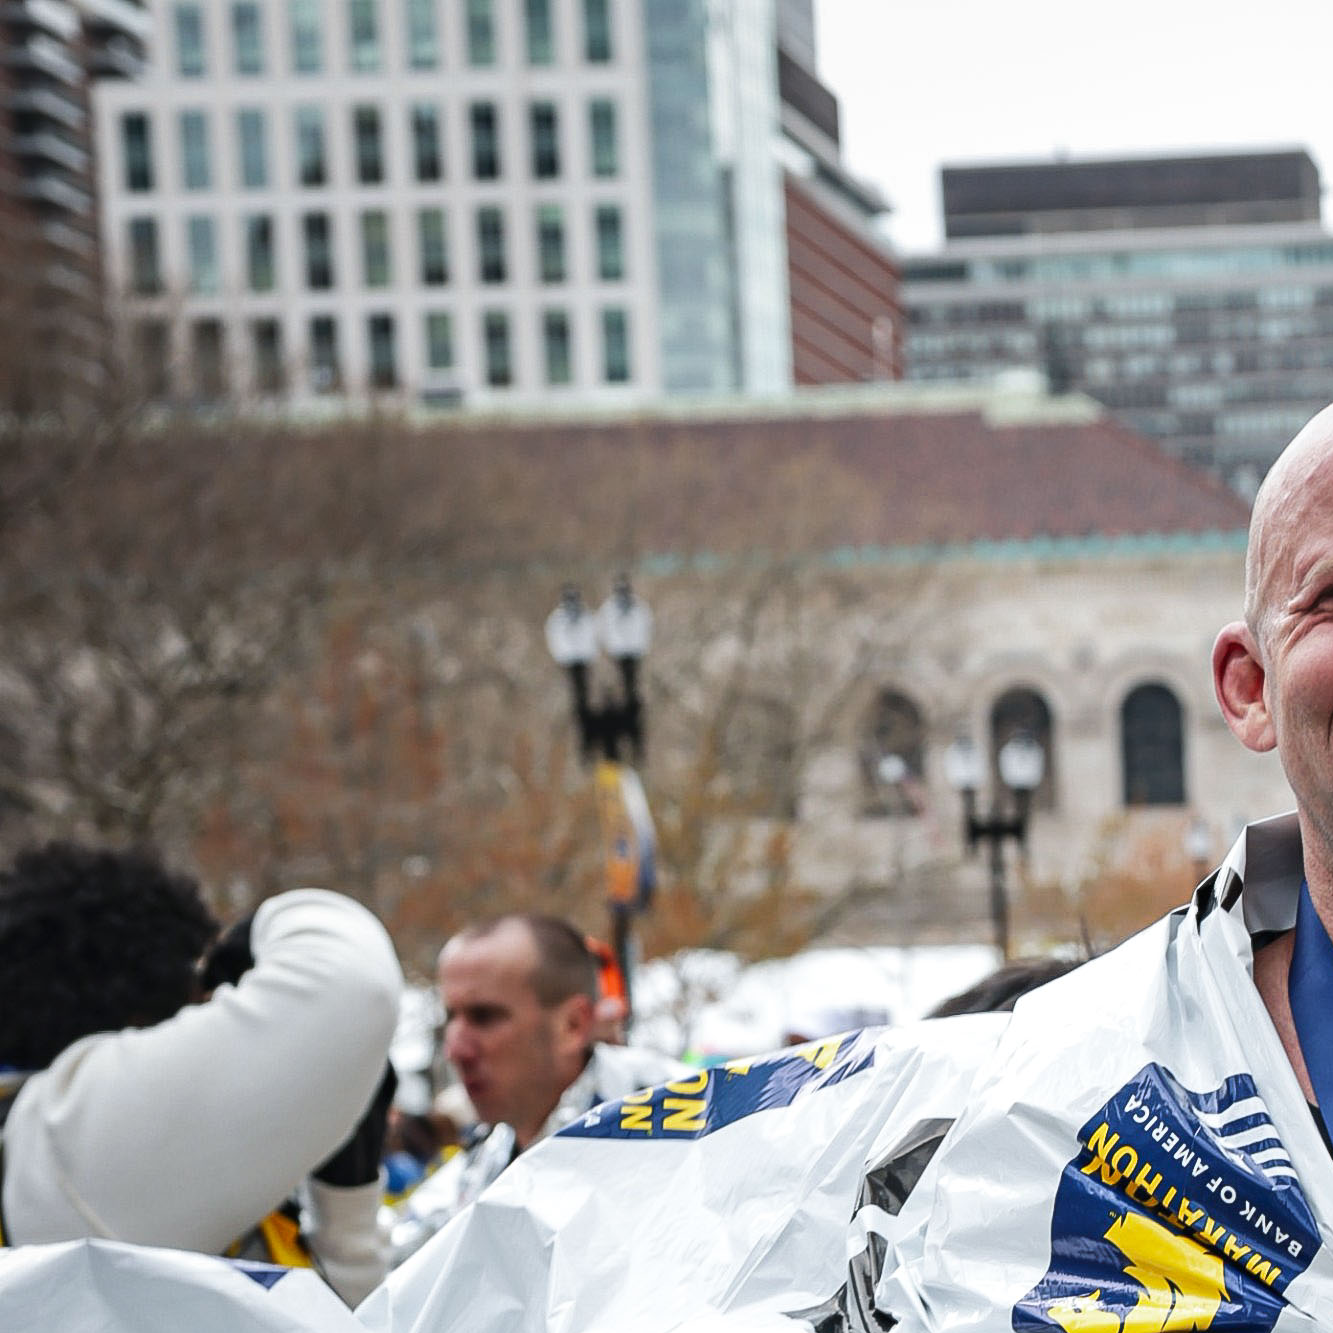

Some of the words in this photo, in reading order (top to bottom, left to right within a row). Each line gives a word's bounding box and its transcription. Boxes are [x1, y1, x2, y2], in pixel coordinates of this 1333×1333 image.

[1123, 1094, 1209, 1178] AMERICA
[1205, 1176, 1237, 1204] OF
[1238, 1200, 1303, 1258] BANK
